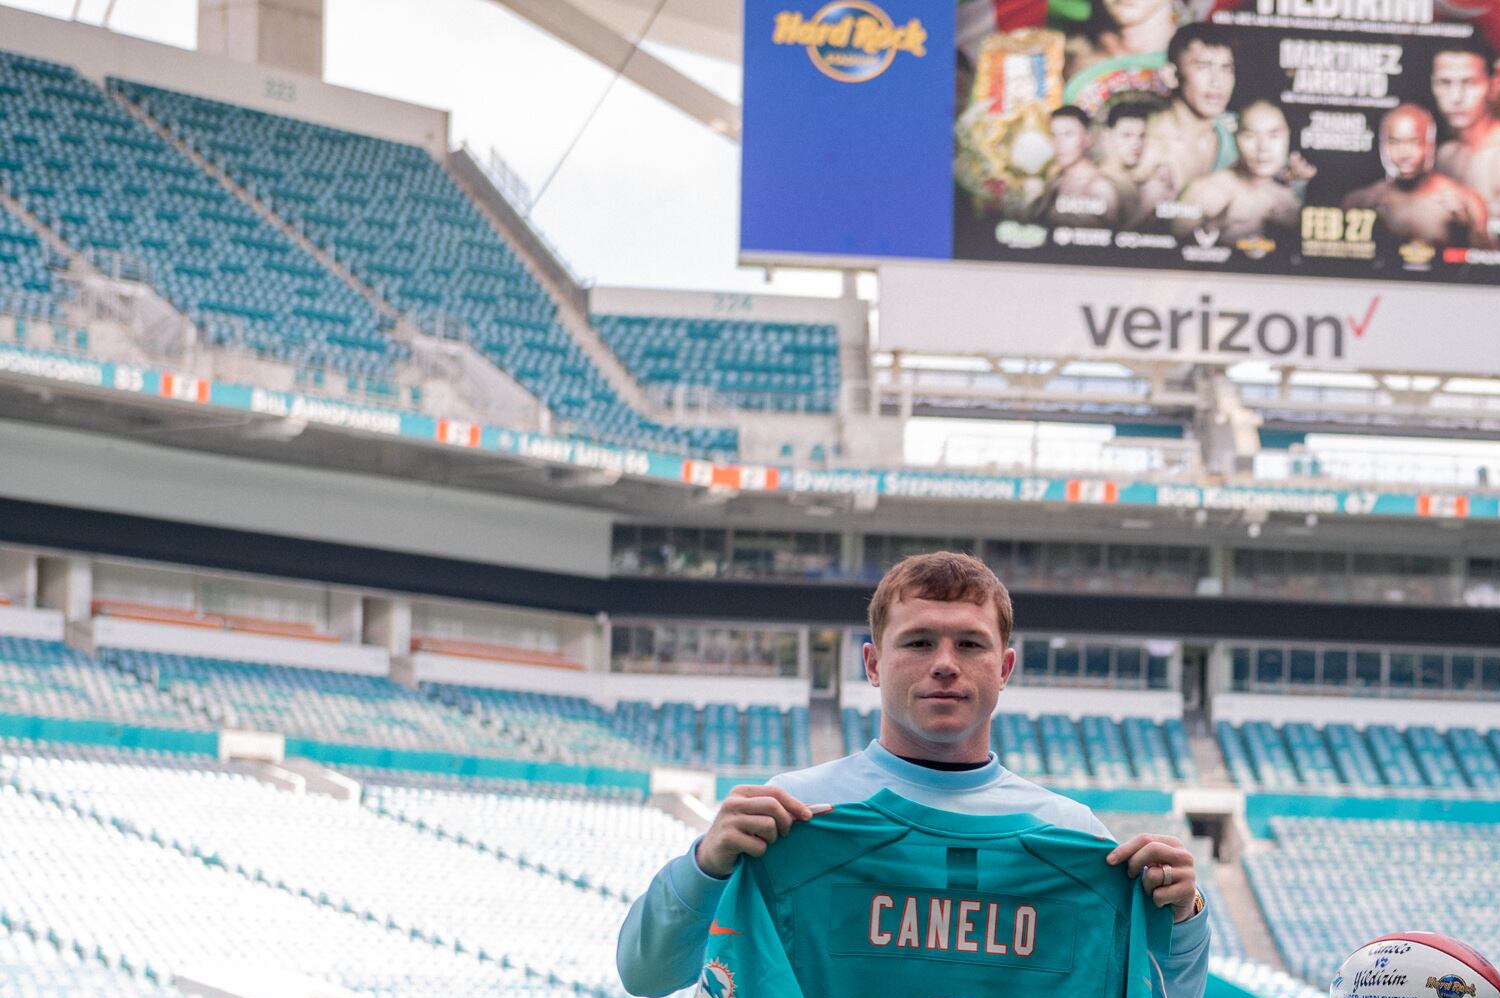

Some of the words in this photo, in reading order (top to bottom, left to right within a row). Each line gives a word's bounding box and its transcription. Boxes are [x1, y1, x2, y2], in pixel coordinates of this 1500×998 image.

[772, 10, 856, 47] Hard
[852, 16, 928, 58] Rock
[1280, 38, 1403, 75] MARTINEZ
[1301, 206, 1344, 240] FEB
[1345, 208, 1376, 241] 27
[1081, 295, 1345, 358] verizon
[868, 893, 1038, 957] CANELO
[1352, 969, 1408, 993] Yildirim
